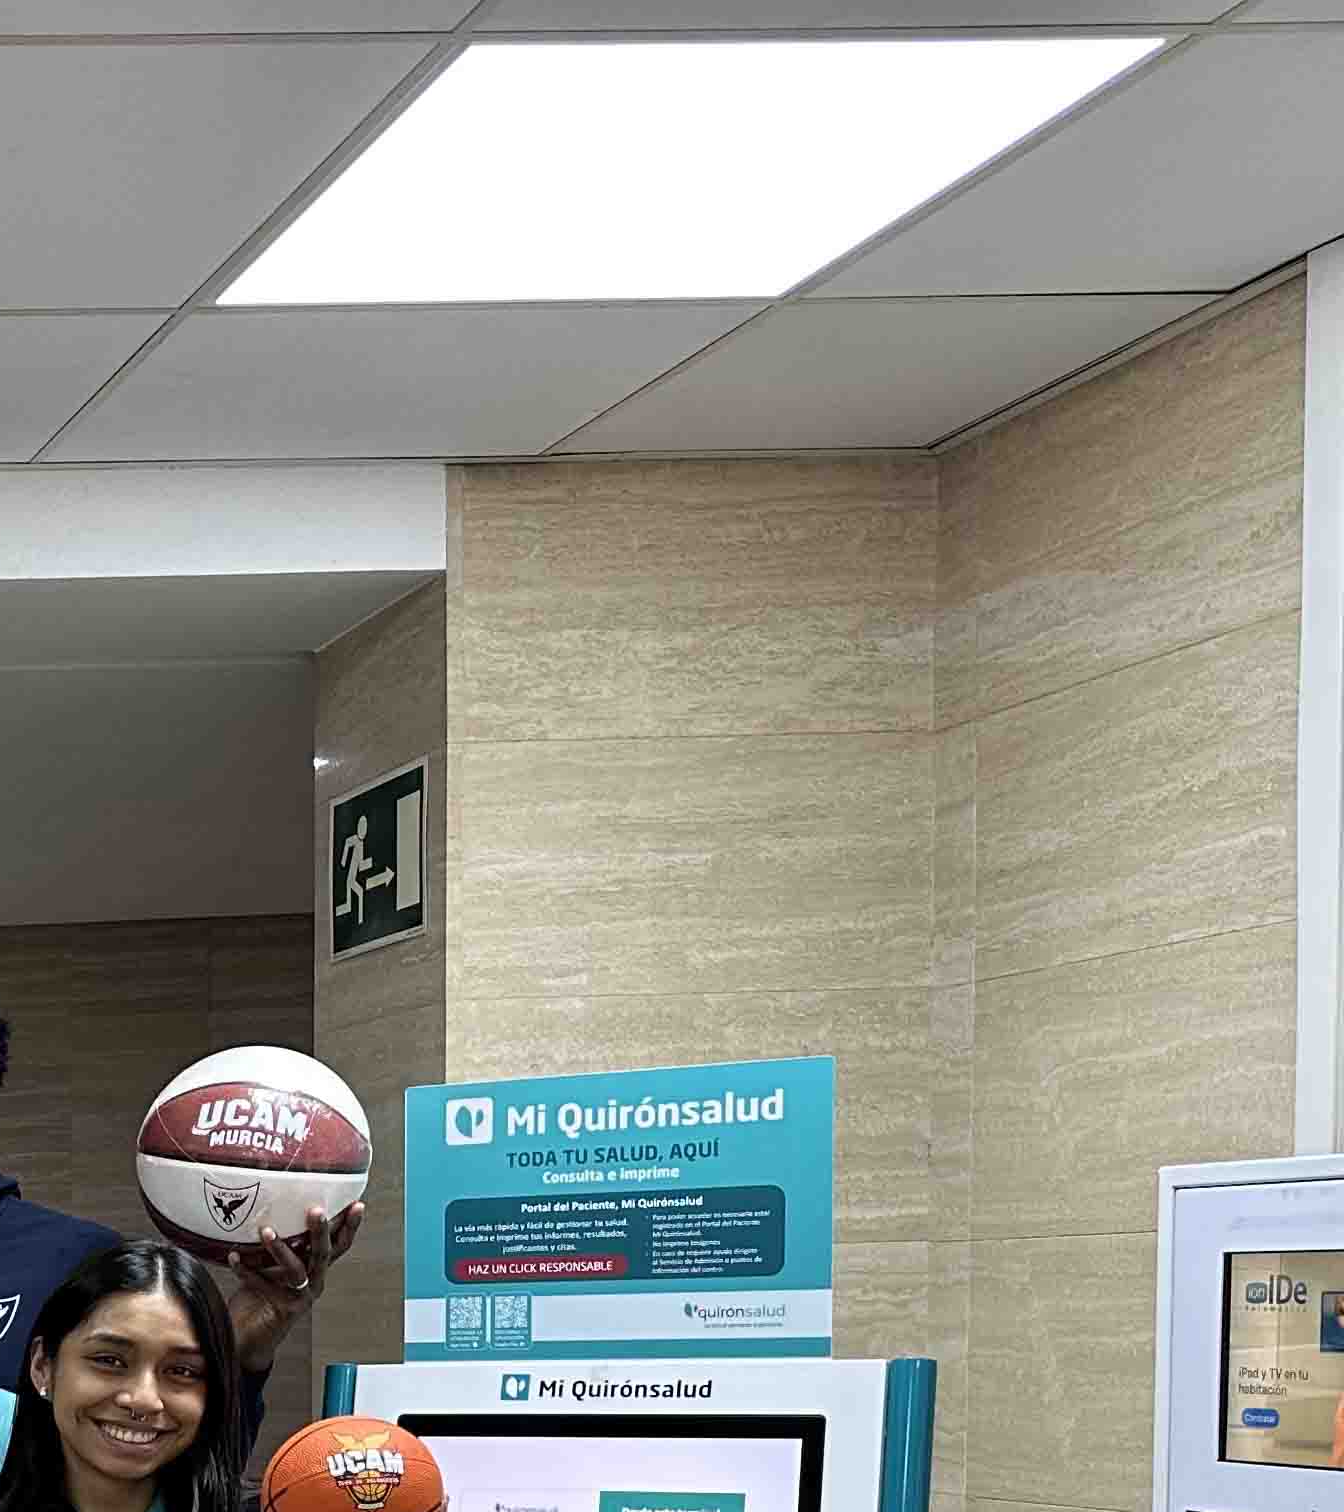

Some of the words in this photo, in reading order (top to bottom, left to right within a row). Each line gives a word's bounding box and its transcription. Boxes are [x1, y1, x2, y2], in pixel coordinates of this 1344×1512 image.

[192, 1098, 309, 1142] UCAM
[506, 1103, 545, 1136] Mi
[557, 1088, 784, 1138] Quirónsalud
[209, 1129, 284, 1153] MURCIA
[506, 1149, 557, 1169] TODA
[563, 1148, 588, 1166] TU
[593, 1143, 664, 1164] SALUD,
[669, 1137, 720, 1160] AQUÍ
[542, 1169, 604, 1185] Consulta
[607, 1170, 617, 1182] e
[521, 1203, 551, 1213] Portal
[553, 1201, 569, 1212] del
[571, 1200, 619, 1211] Paciente,
[638, 1196, 704, 1209] Quirónsalud
[468, 1264, 489, 1275] HAZ
[491, 1263, 507, 1274] UN
[509, 1262, 537, 1274] CLICK
[539, 1260, 613, 1273] RESPONSABLE
[1269, 1367, 1282, 1379] TV
[538, 1380, 563, 1398] Mi
[571, 1378, 712, 1402] Quirónsalud
[326, 1448, 404, 1477] UCAM
